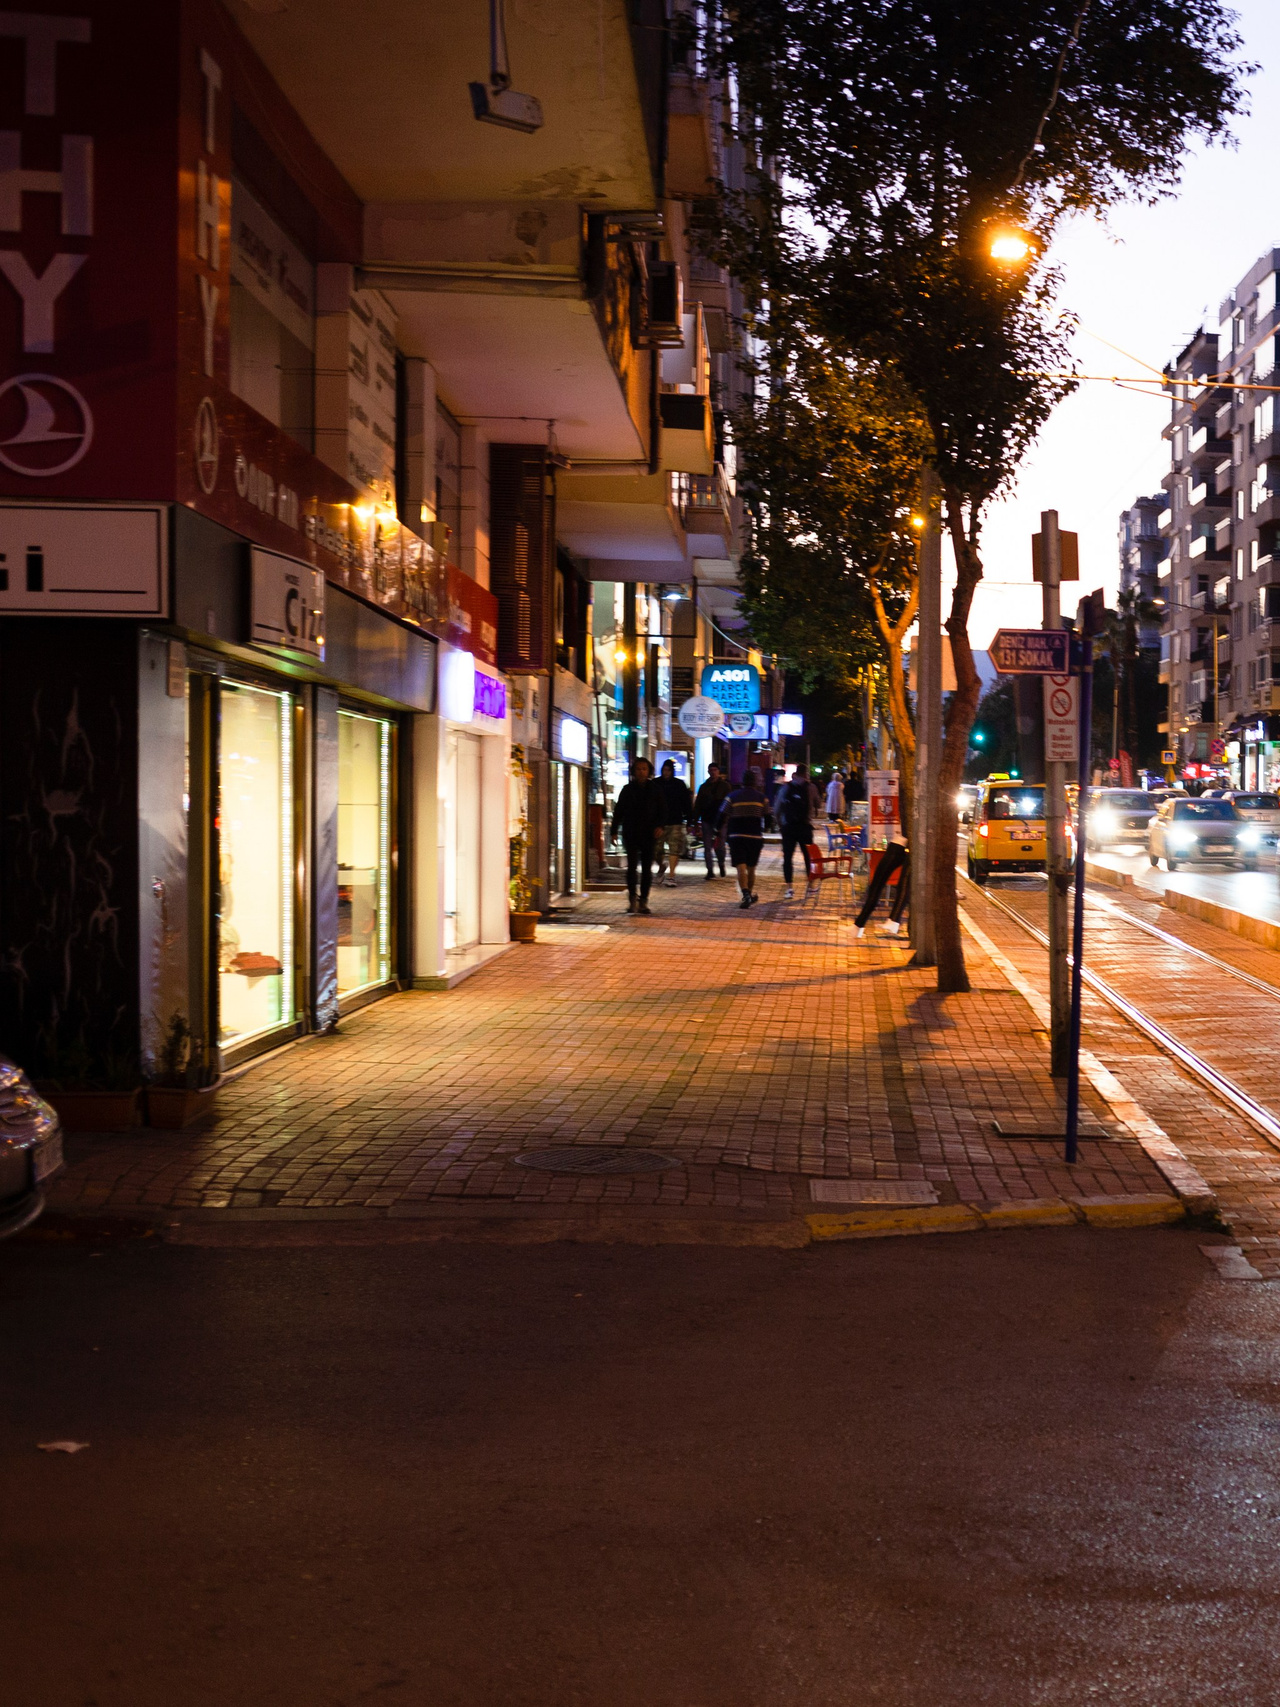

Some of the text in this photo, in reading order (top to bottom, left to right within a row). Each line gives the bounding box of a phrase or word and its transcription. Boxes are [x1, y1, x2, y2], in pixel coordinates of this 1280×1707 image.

[0, 11, 94, 354] THY
[1019, 650, 1054, 666] SOKAK
[711, 683, 749, 692] HARCA
[711, 692, 750, 701] HARCA
